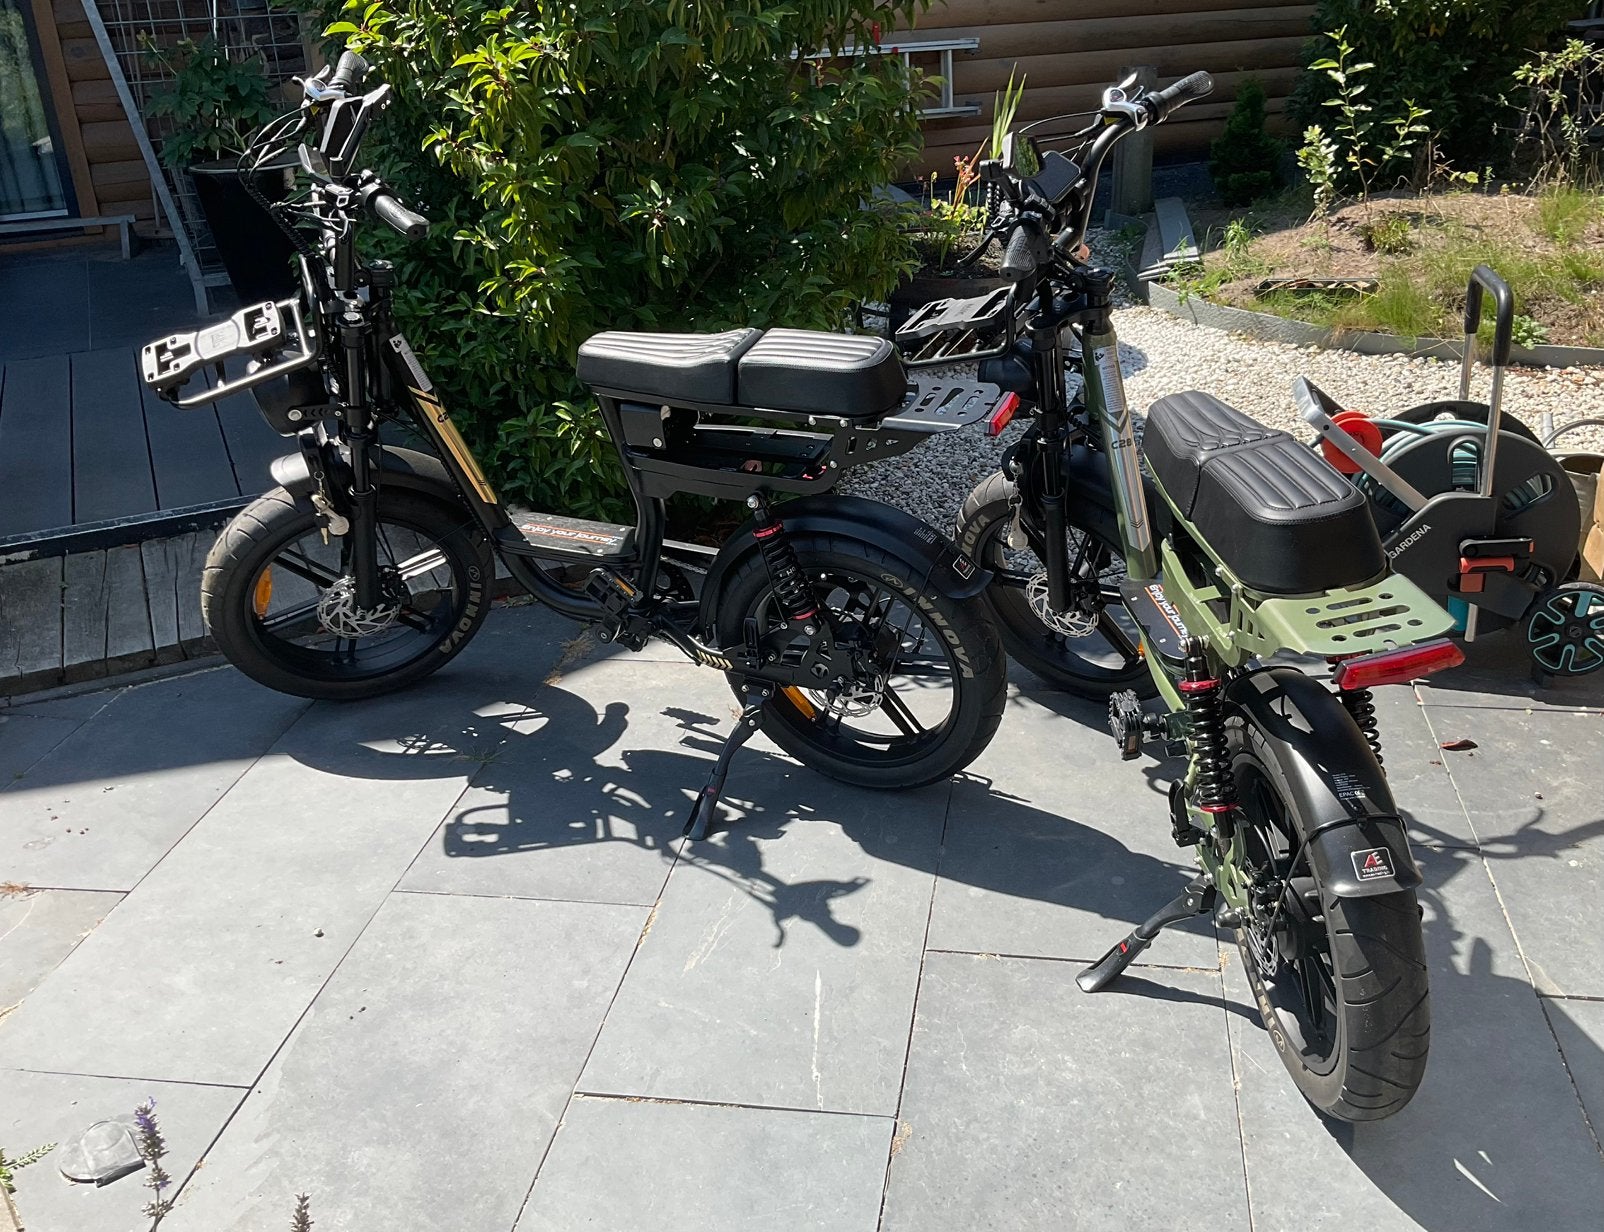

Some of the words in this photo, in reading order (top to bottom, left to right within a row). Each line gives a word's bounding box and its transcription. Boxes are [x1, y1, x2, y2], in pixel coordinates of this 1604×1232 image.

[1111, 438, 1132, 450] C28
[521, 524, 552, 534] Enjoy
[551, 529, 577, 537] your
[1388, 524, 1432, 559] GARDENA
[1149, 584, 1166, 602] Enjoy
[1158, 600, 1176, 615] your
[439, 582, 482, 653] INNOVA
[903, 587, 975, 678] INNOVA
